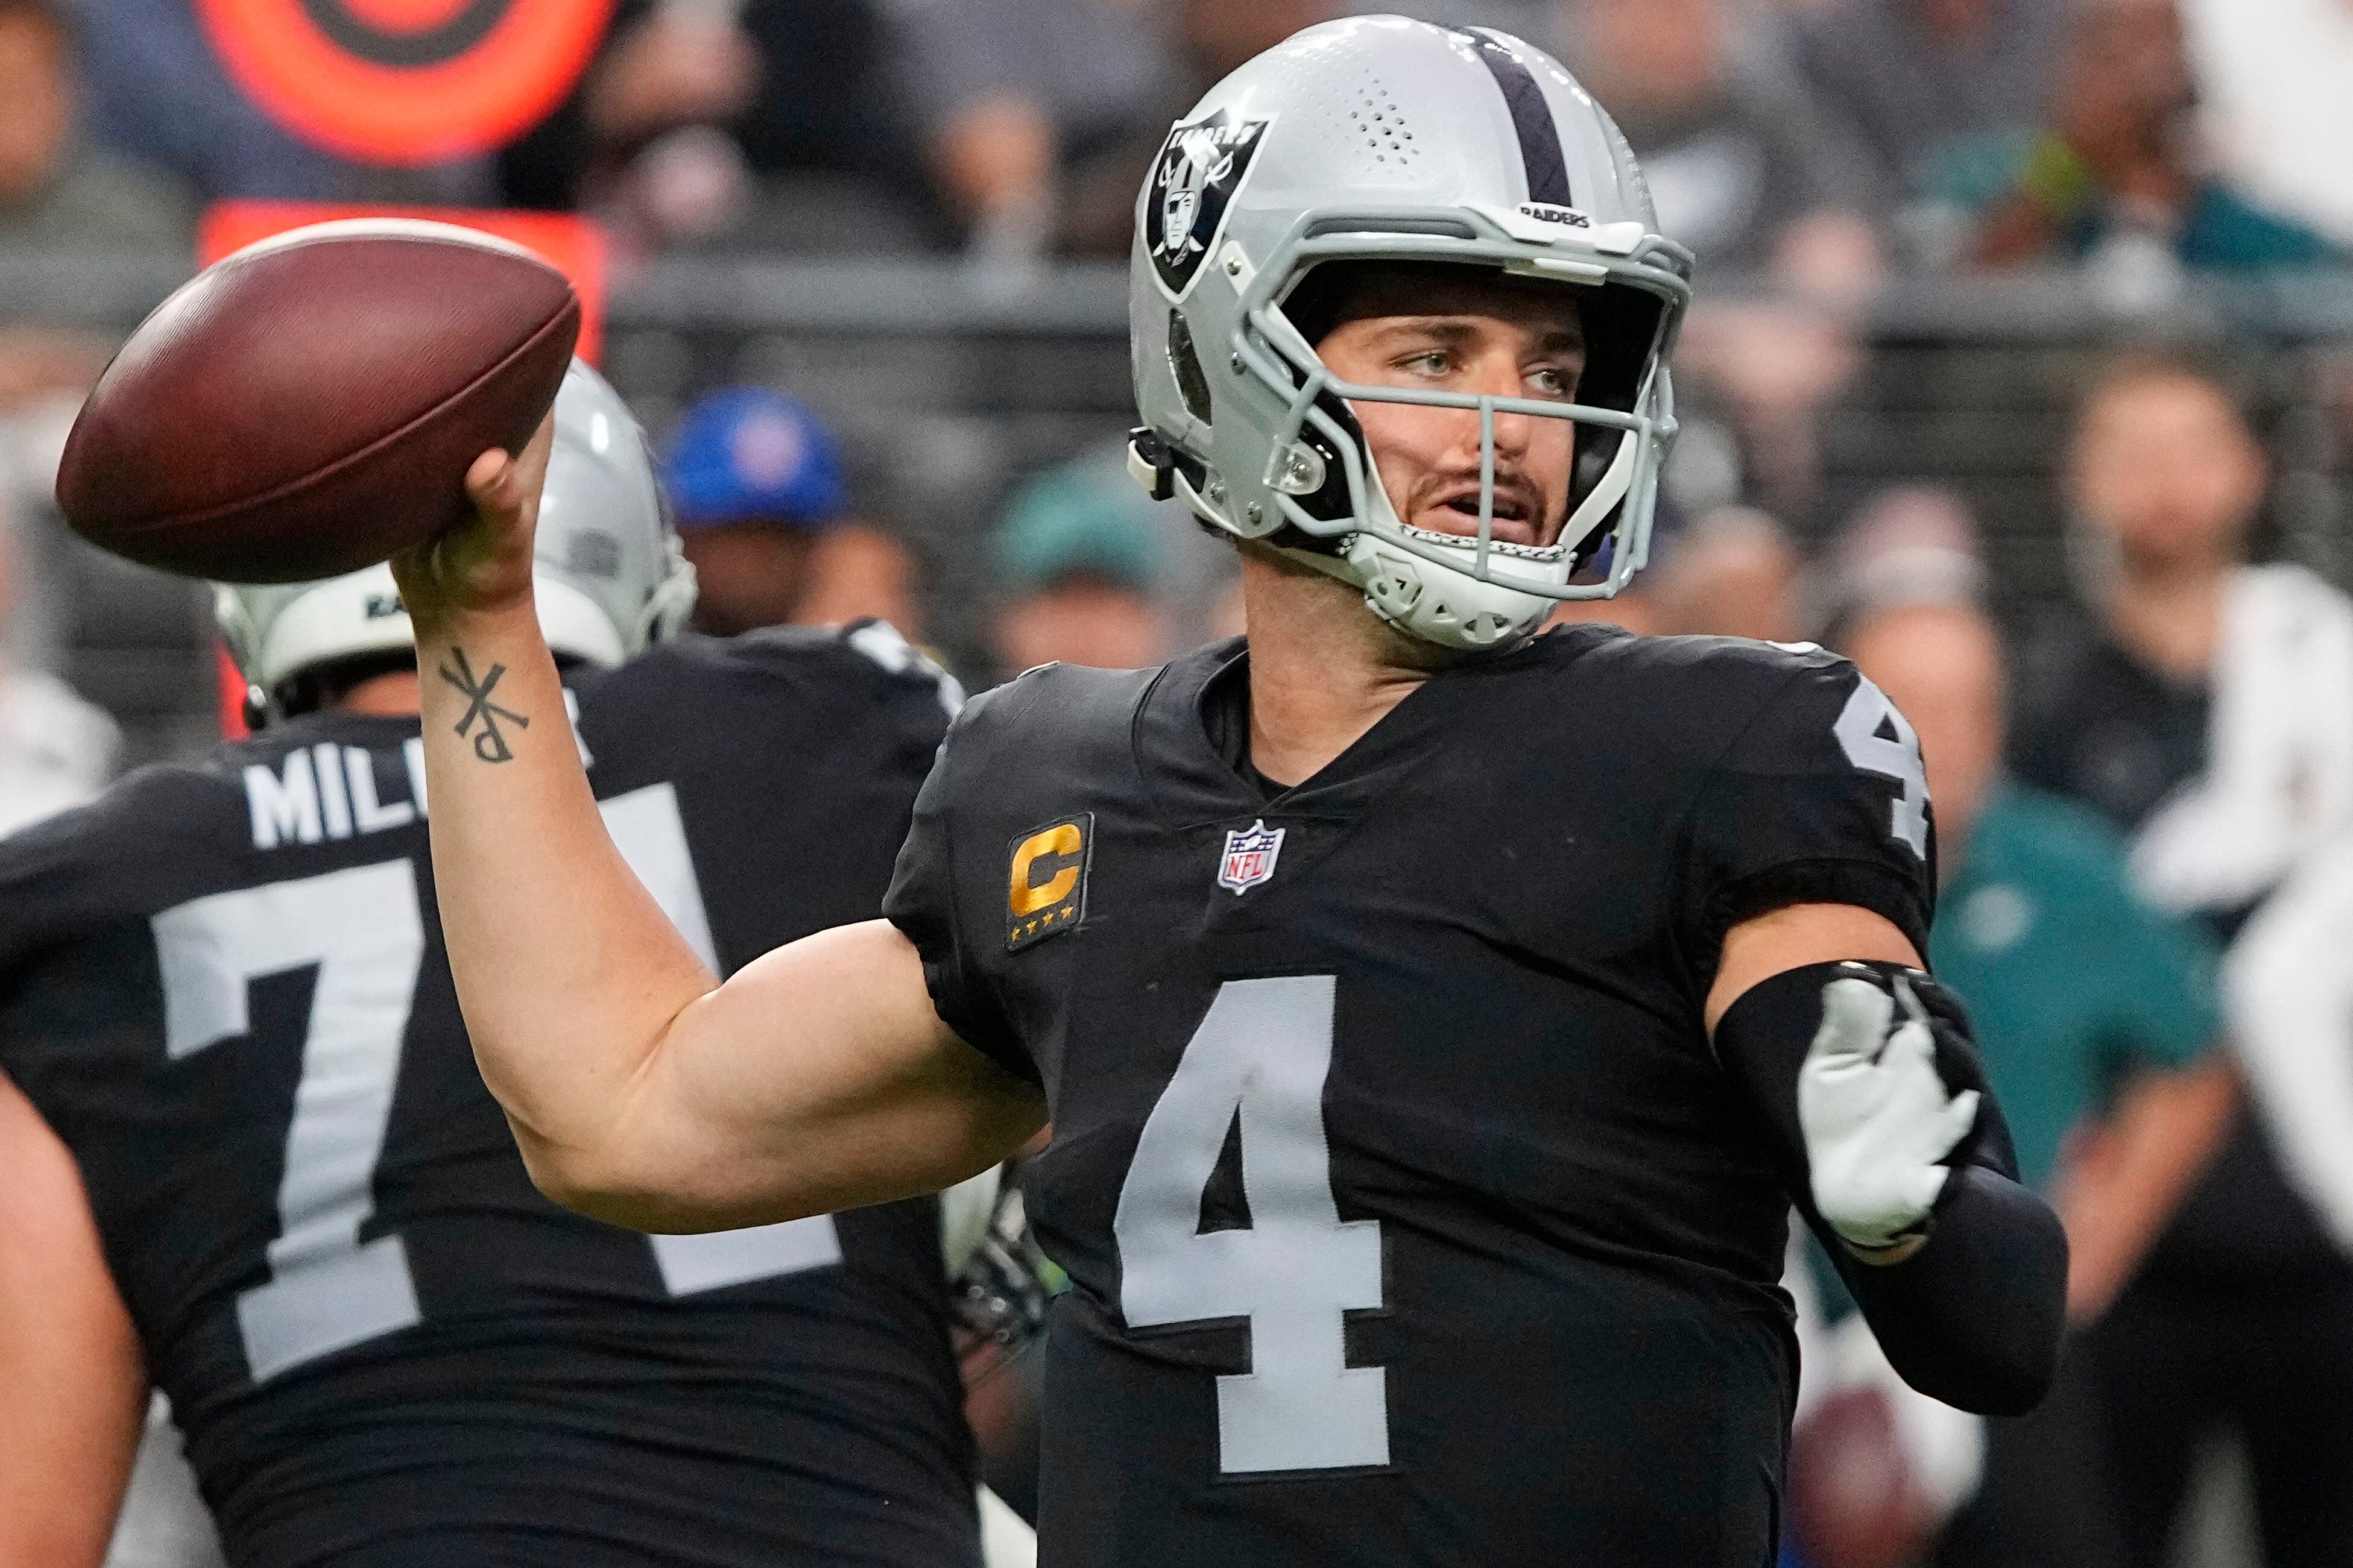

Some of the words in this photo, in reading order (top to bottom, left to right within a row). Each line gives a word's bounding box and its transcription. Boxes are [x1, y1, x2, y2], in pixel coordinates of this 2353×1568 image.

[1833, 671, 1931, 861] 4
[1011, 823, 1082, 918] C
[1226, 853, 1263, 880] NFL
[1113, 975, 1390, 1473] 4
